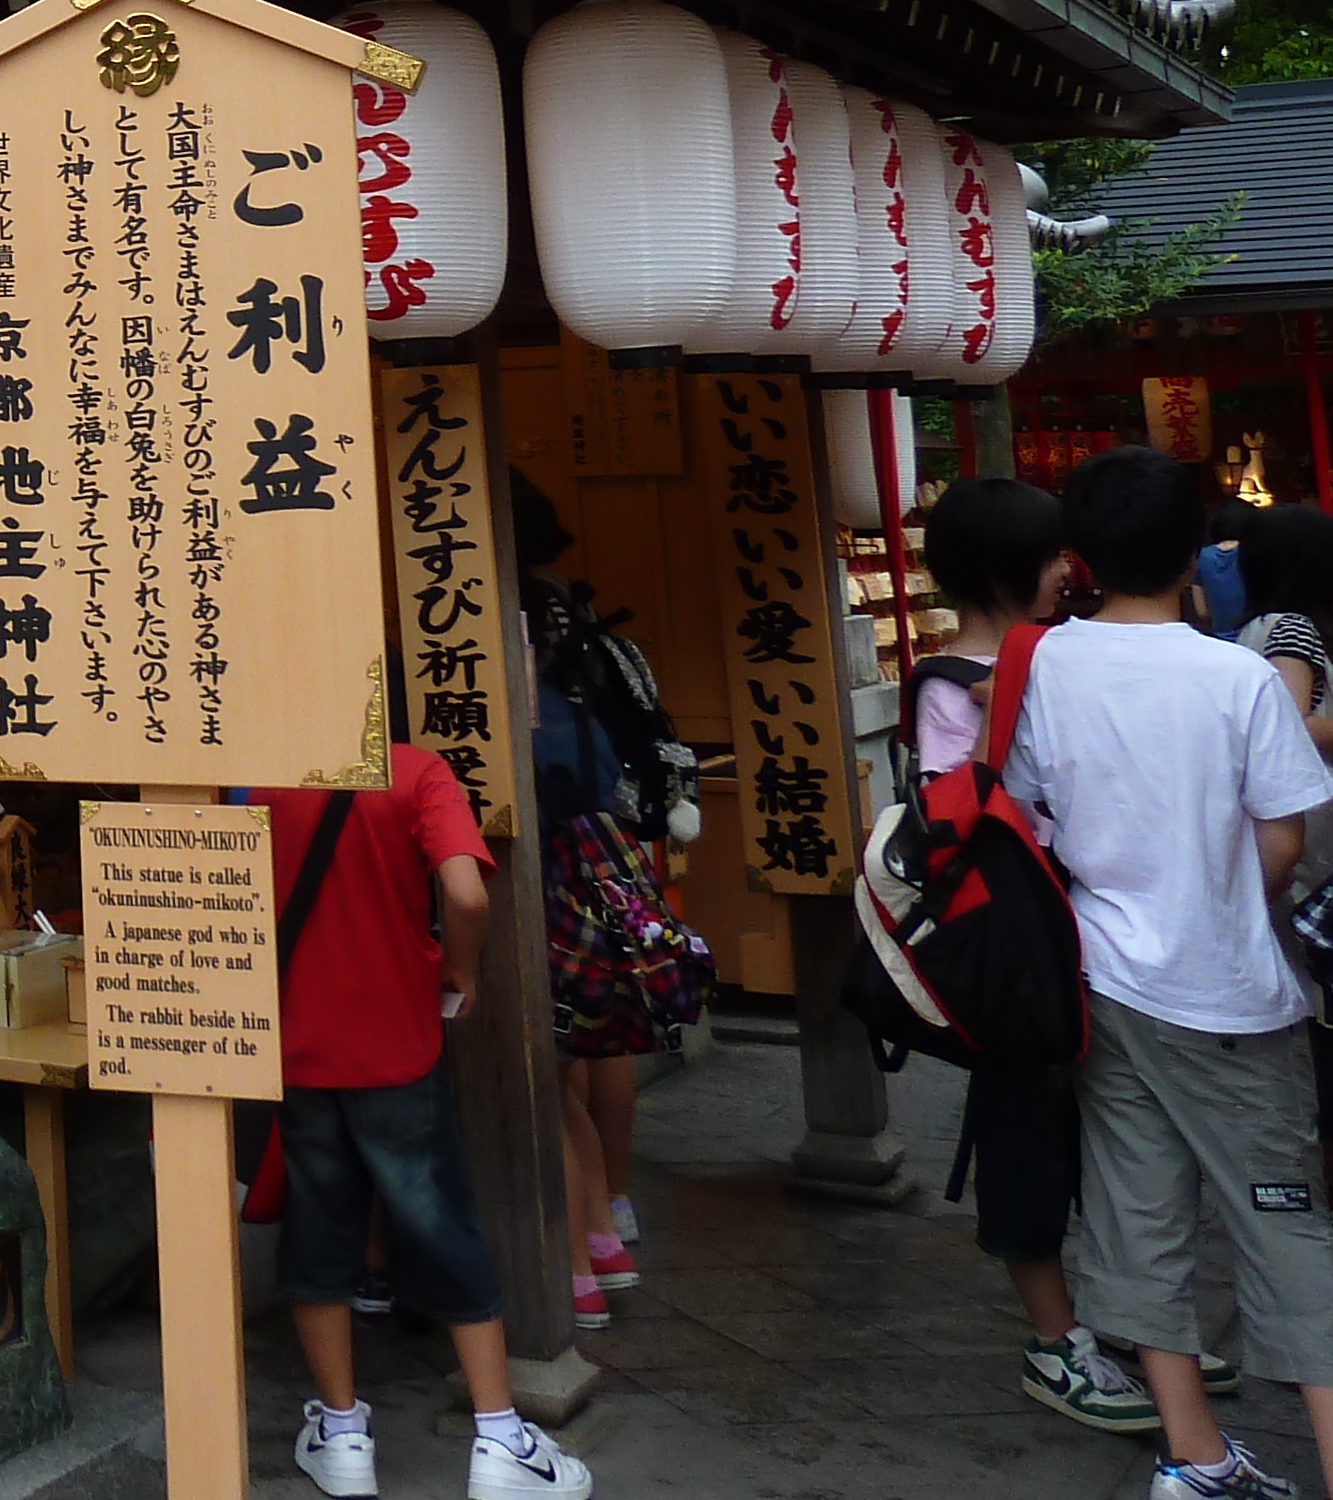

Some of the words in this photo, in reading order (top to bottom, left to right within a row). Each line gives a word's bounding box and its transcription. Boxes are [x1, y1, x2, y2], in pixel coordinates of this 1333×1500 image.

[226, 142, 337, 515] ご利益
[165, 101, 229, 746] 大国主命さまはえんむすびのご利益がある神さま
[101, 863, 133, 881] This
[140, 867, 183, 884] statue
[190, 867, 202, 884] is
[208, 868, 251, 886] called
[105, 922, 116, 939] A
[123, 922, 182, 942] japanese
[188, 925, 213, 945] god
[220, 929, 247, 944] who
[253, 927, 265, 945] is
[95, 946, 109, 964] in
[116, 947, 163, 969] charge
[170, 949, 185, 966] of
[191, 951, 219, 969] love
[226, 953, 252, 970] and
[96, 974, 130, 992] good
[137, 975, 200, 994] matches.
[106, 1004, 133, 1024] The
[141, 1008, 183, 1025] rabbit
[190, 1009, 235, 1029] beside
[242, 1012, 270, 1030] him
[98, 1031, 111, 1047] is
[116, 1036, 125, 1049] a
[130, 1036, 207, 1055] messenger
[213, 1038, 228, 1055] of
[235, 1039, 257, 1055] the
[99, 1057, 132, 1075] god.
